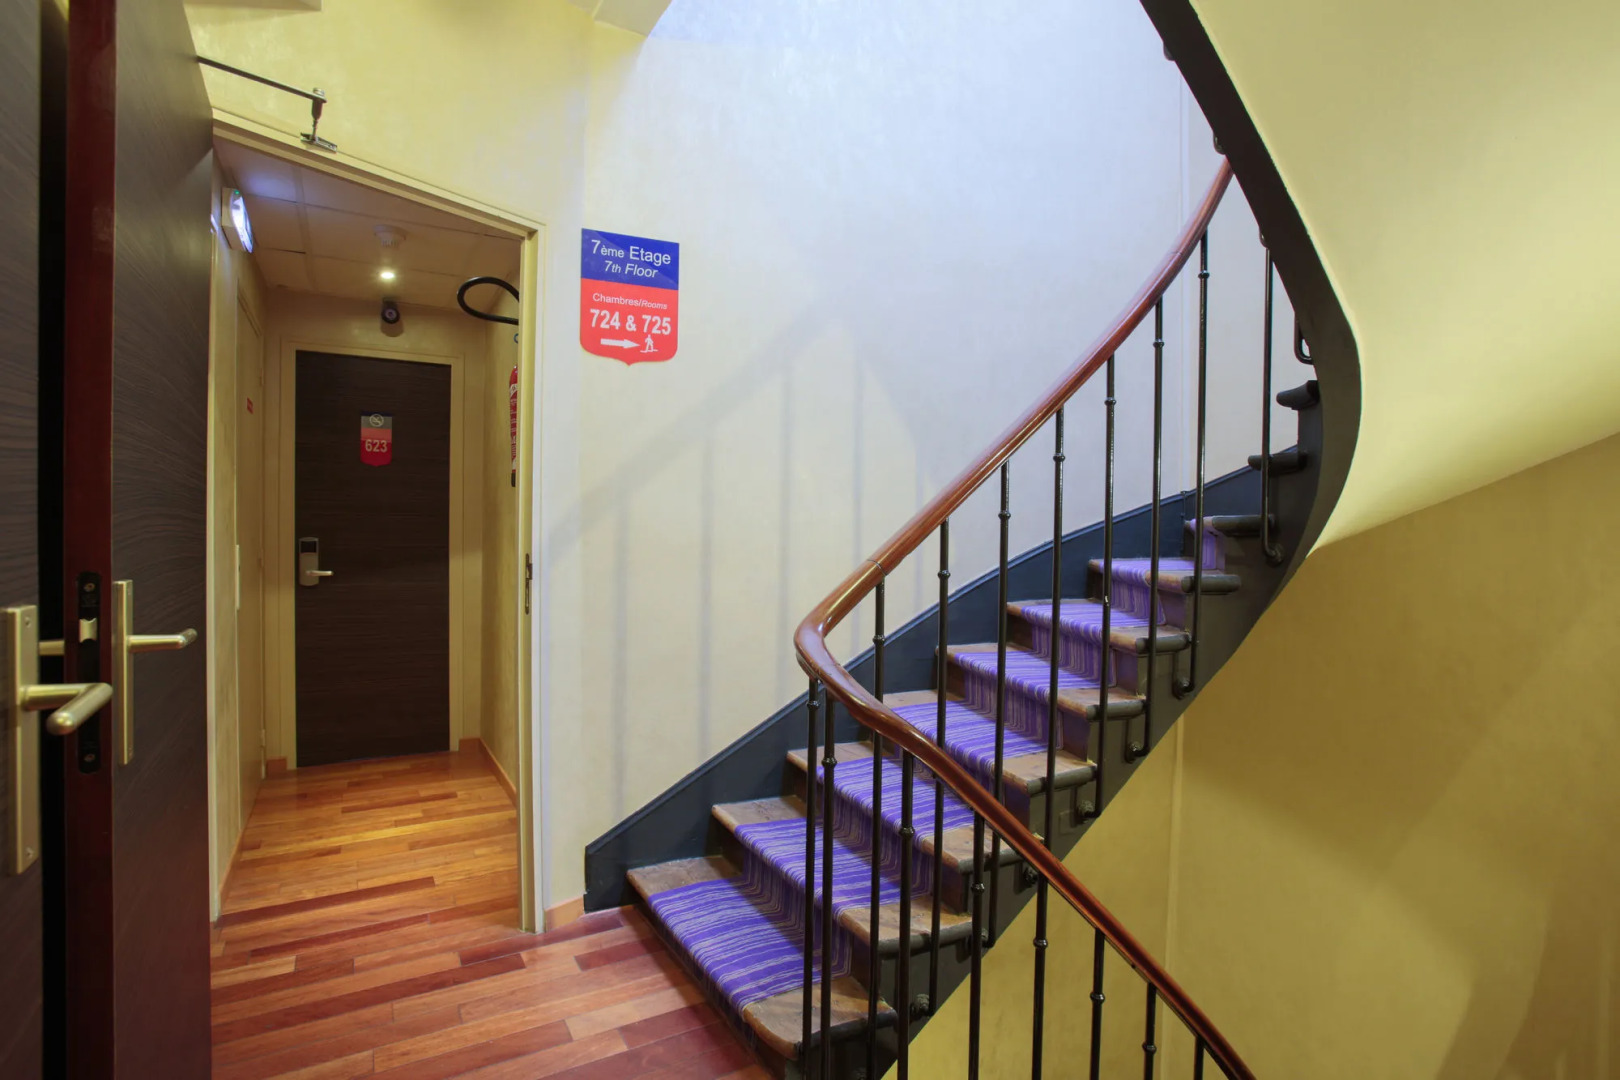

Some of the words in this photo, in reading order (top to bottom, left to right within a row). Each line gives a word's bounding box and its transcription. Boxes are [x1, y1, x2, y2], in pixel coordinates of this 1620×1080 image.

[591, 239, 625, 258] 7ème
[629, 245, 671, 266] Etage
[604, 260, 622, 274] 7th
[625, 263, 658, 278] Floor
[590, 308, 621, 330] 724
[625, 314, 637, 332] &
[642, 314, 671, 335] 725
[365, 438, 388, 453] 623
